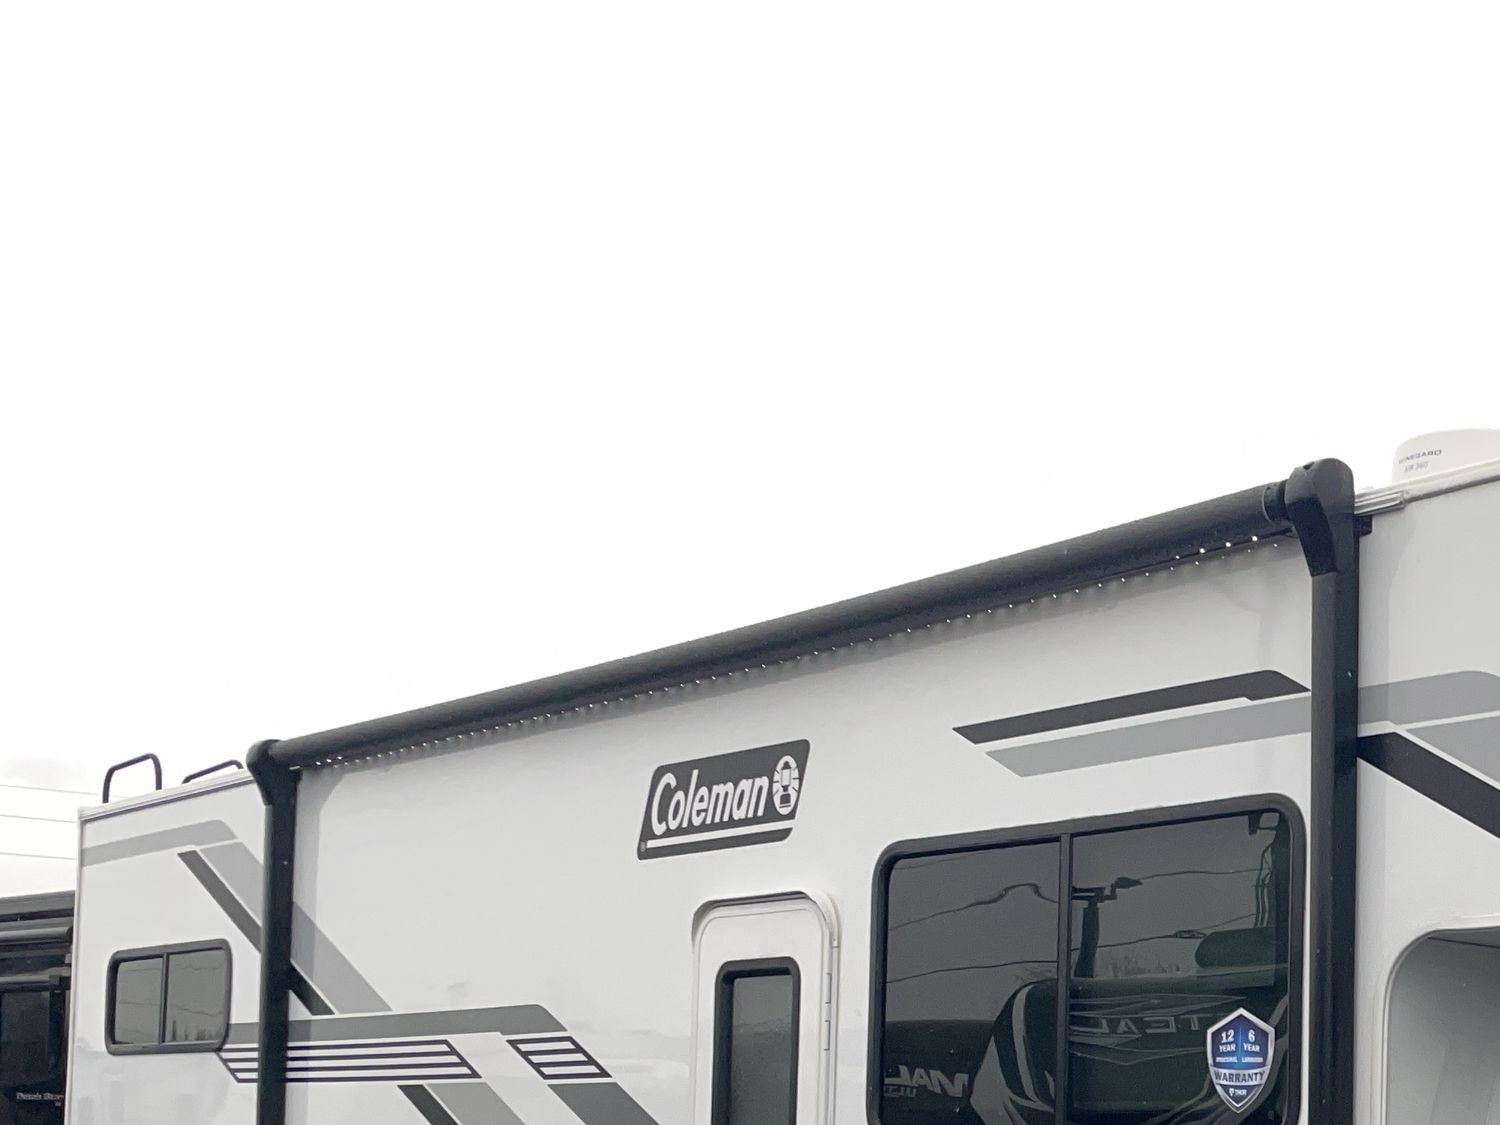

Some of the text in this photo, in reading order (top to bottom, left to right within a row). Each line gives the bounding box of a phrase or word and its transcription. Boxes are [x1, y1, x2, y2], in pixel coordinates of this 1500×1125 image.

[651, 769, 770, 836] Coleman
[1221, 1029, 1235, 1043] 12
[1248, 1029, 1256, 1042] 6
[1219, 1043, 1236, 1052] YEAR
[1243, 1043, 1260, 1052] YEAR
[1214, 1070, 1266, 1083] WARRANTY
